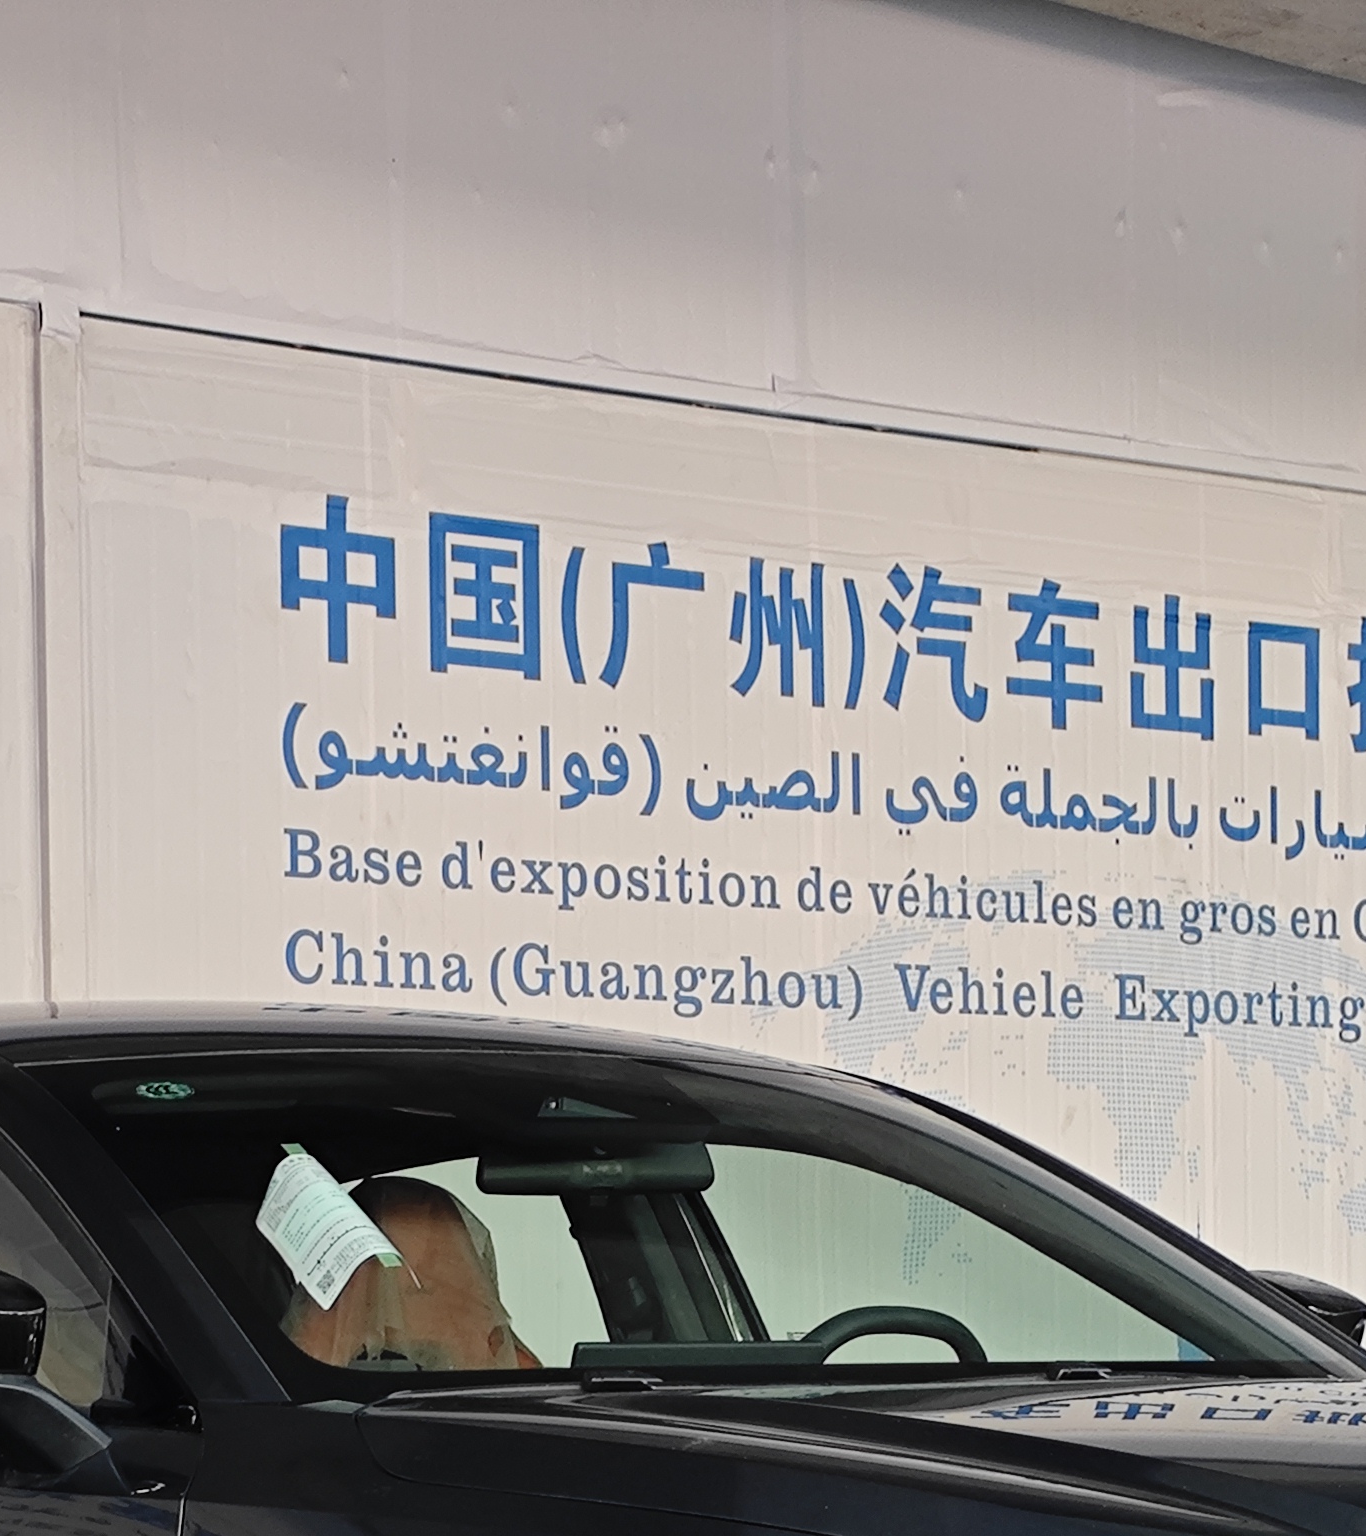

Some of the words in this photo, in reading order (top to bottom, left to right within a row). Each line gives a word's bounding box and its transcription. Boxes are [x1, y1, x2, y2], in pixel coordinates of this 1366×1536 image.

[688, 752, 861, 821] الصين
[887, 758, 978, 836] في
[1000, 764, 1200, 845] بالجملة
[285, 830, 422, 887] Base
[443, 842, 781, 911] d'exposition
[799, 868, 852, 914] de
[869, 870, 1097, 928] véhicules
[1112, 893, 1165, 931] en
[1181, 902, 1277, 945] gros
[1292, 909, 1340, 940] en
[287, 931, 473, 993] China
[489, 943, 864, 1021] (Guangzhou)
[1116, 975, 1365, 1044] Exporting
